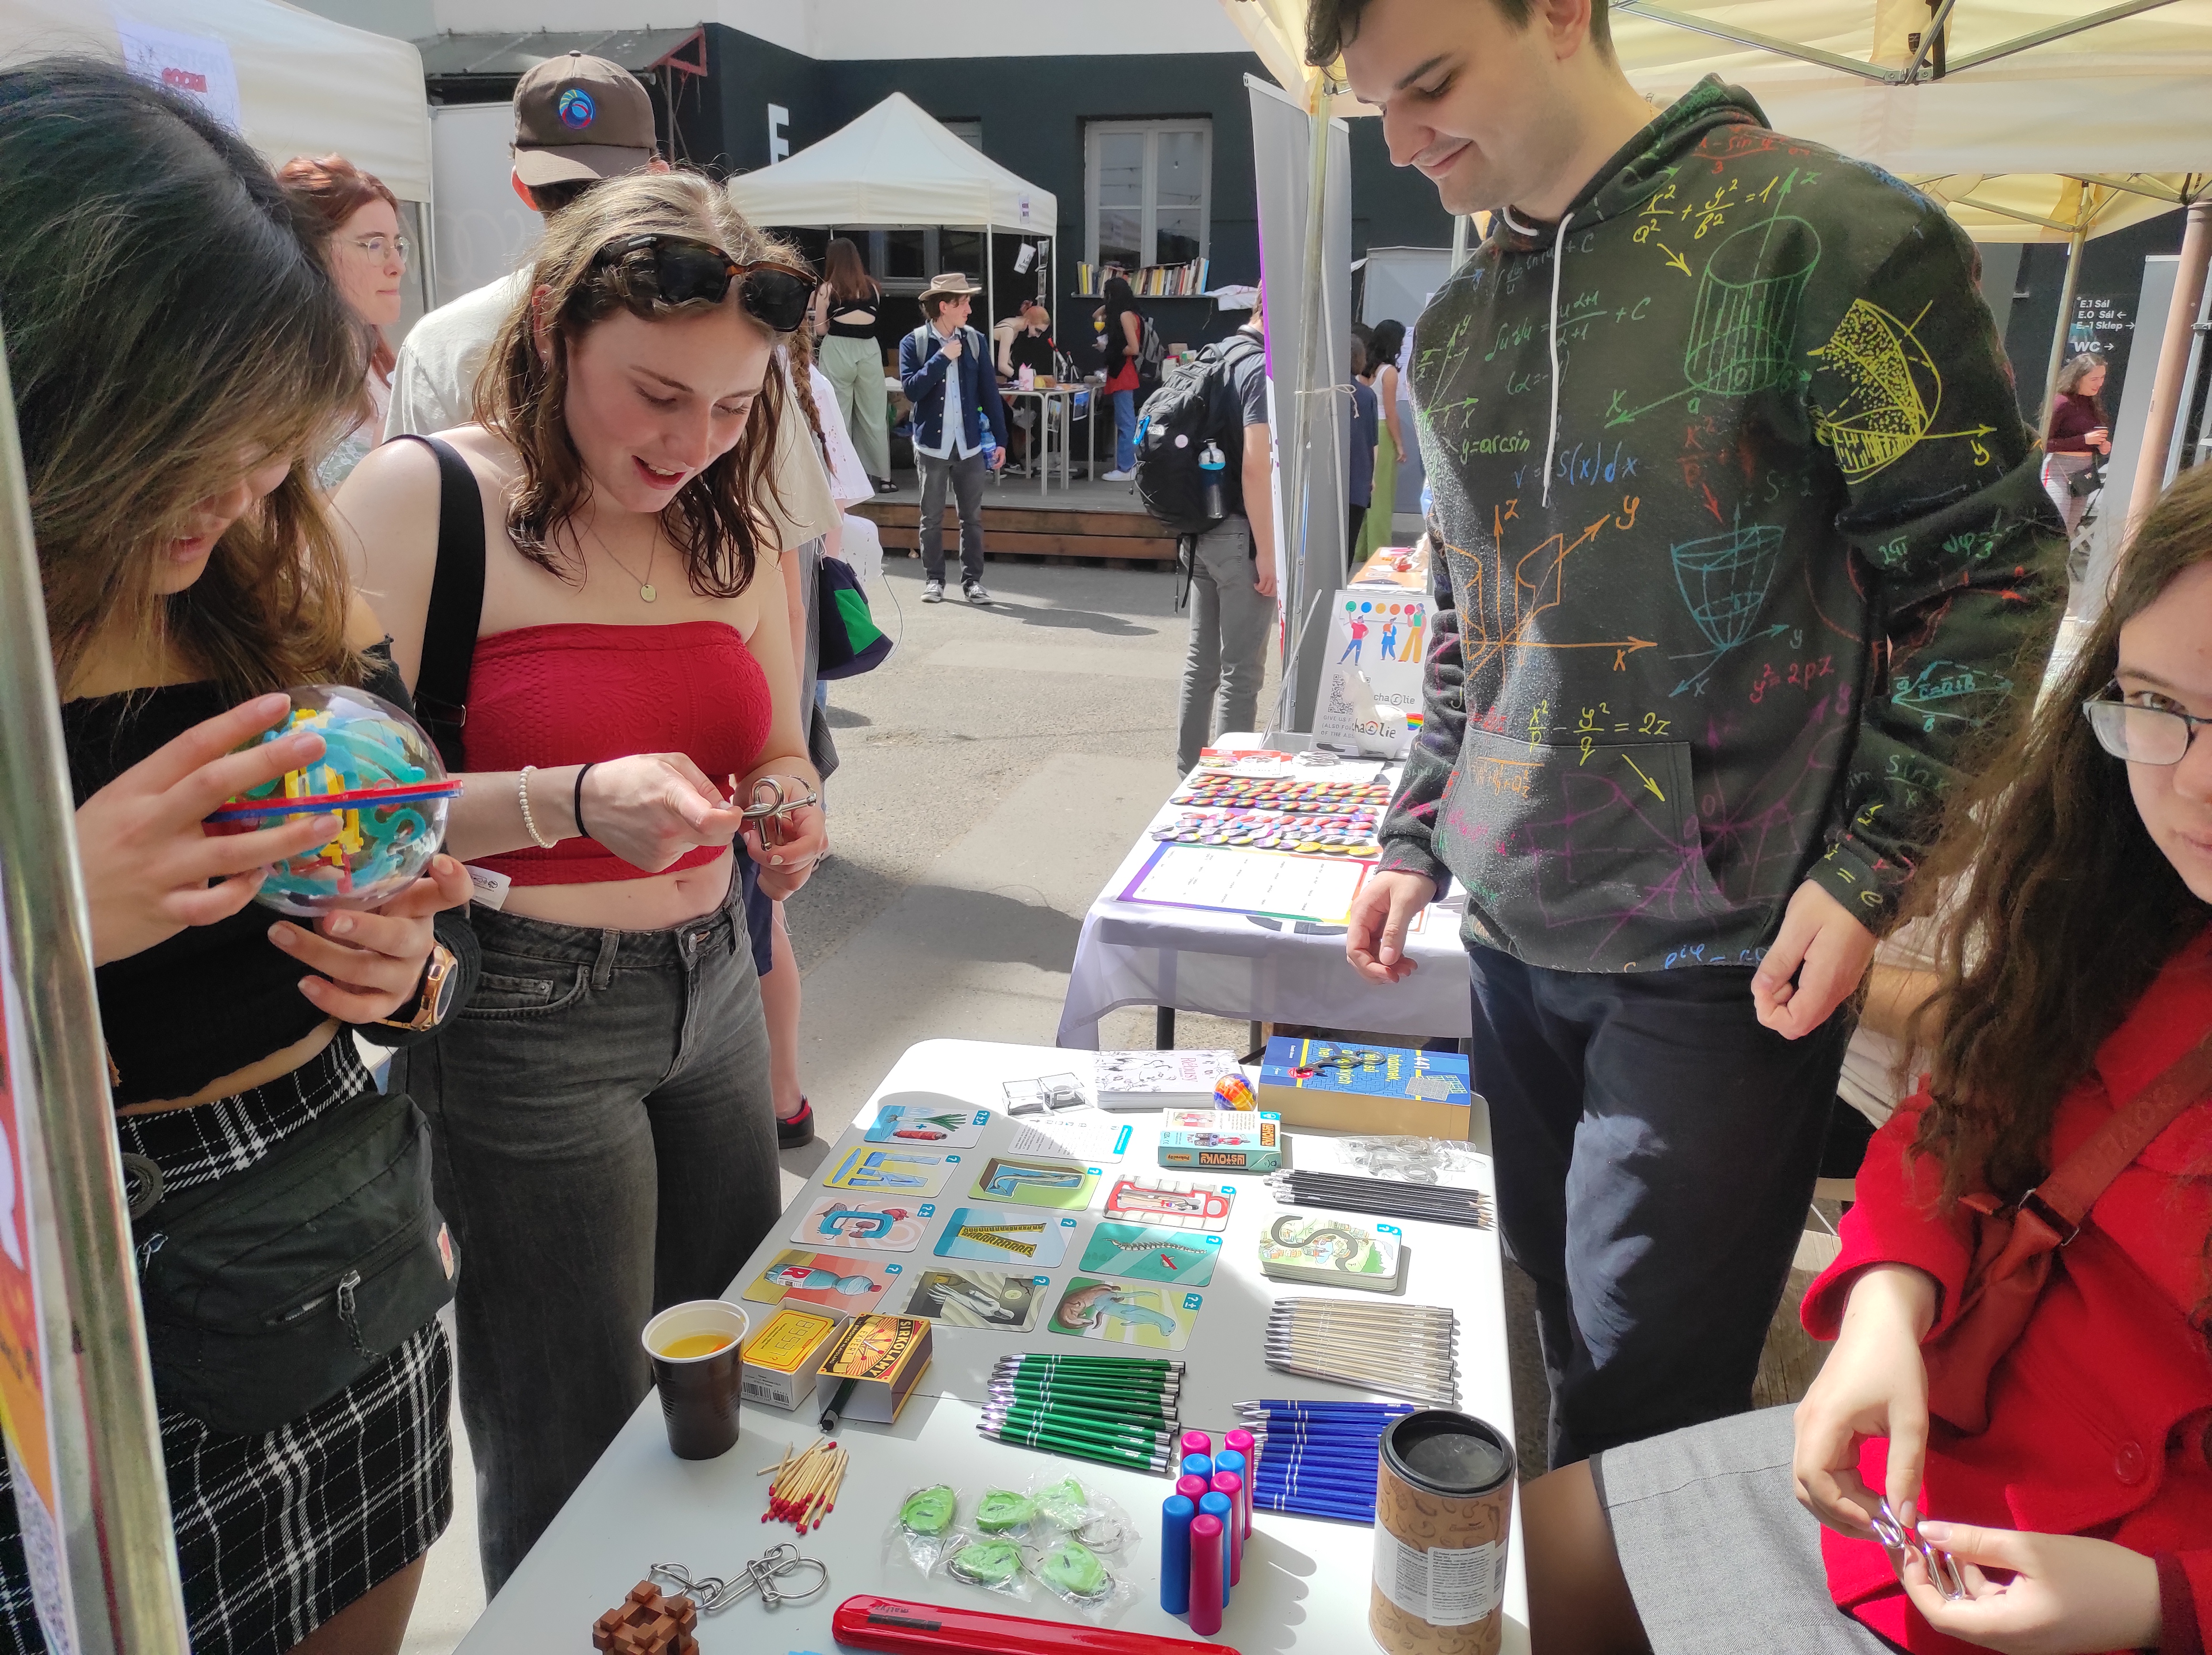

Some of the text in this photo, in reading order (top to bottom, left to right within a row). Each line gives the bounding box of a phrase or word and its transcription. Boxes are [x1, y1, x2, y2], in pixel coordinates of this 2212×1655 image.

[2094, 299, 2110, 308] Sál
[2098, 310, 2115, 319] Sál
[2095, 321, 2123, 332] Sklep
[2074, 341, 2101, 352] WC
[1413, 1056, 1431, 1070] 441
[1180, 1058, 1198, 1083] Rébusy
[845, 1330, 868, 1356] EXPERT
[869, 1320, 913, 1377] SIRKOLAMY
[875, 1604, 911, 1614] matfyz
